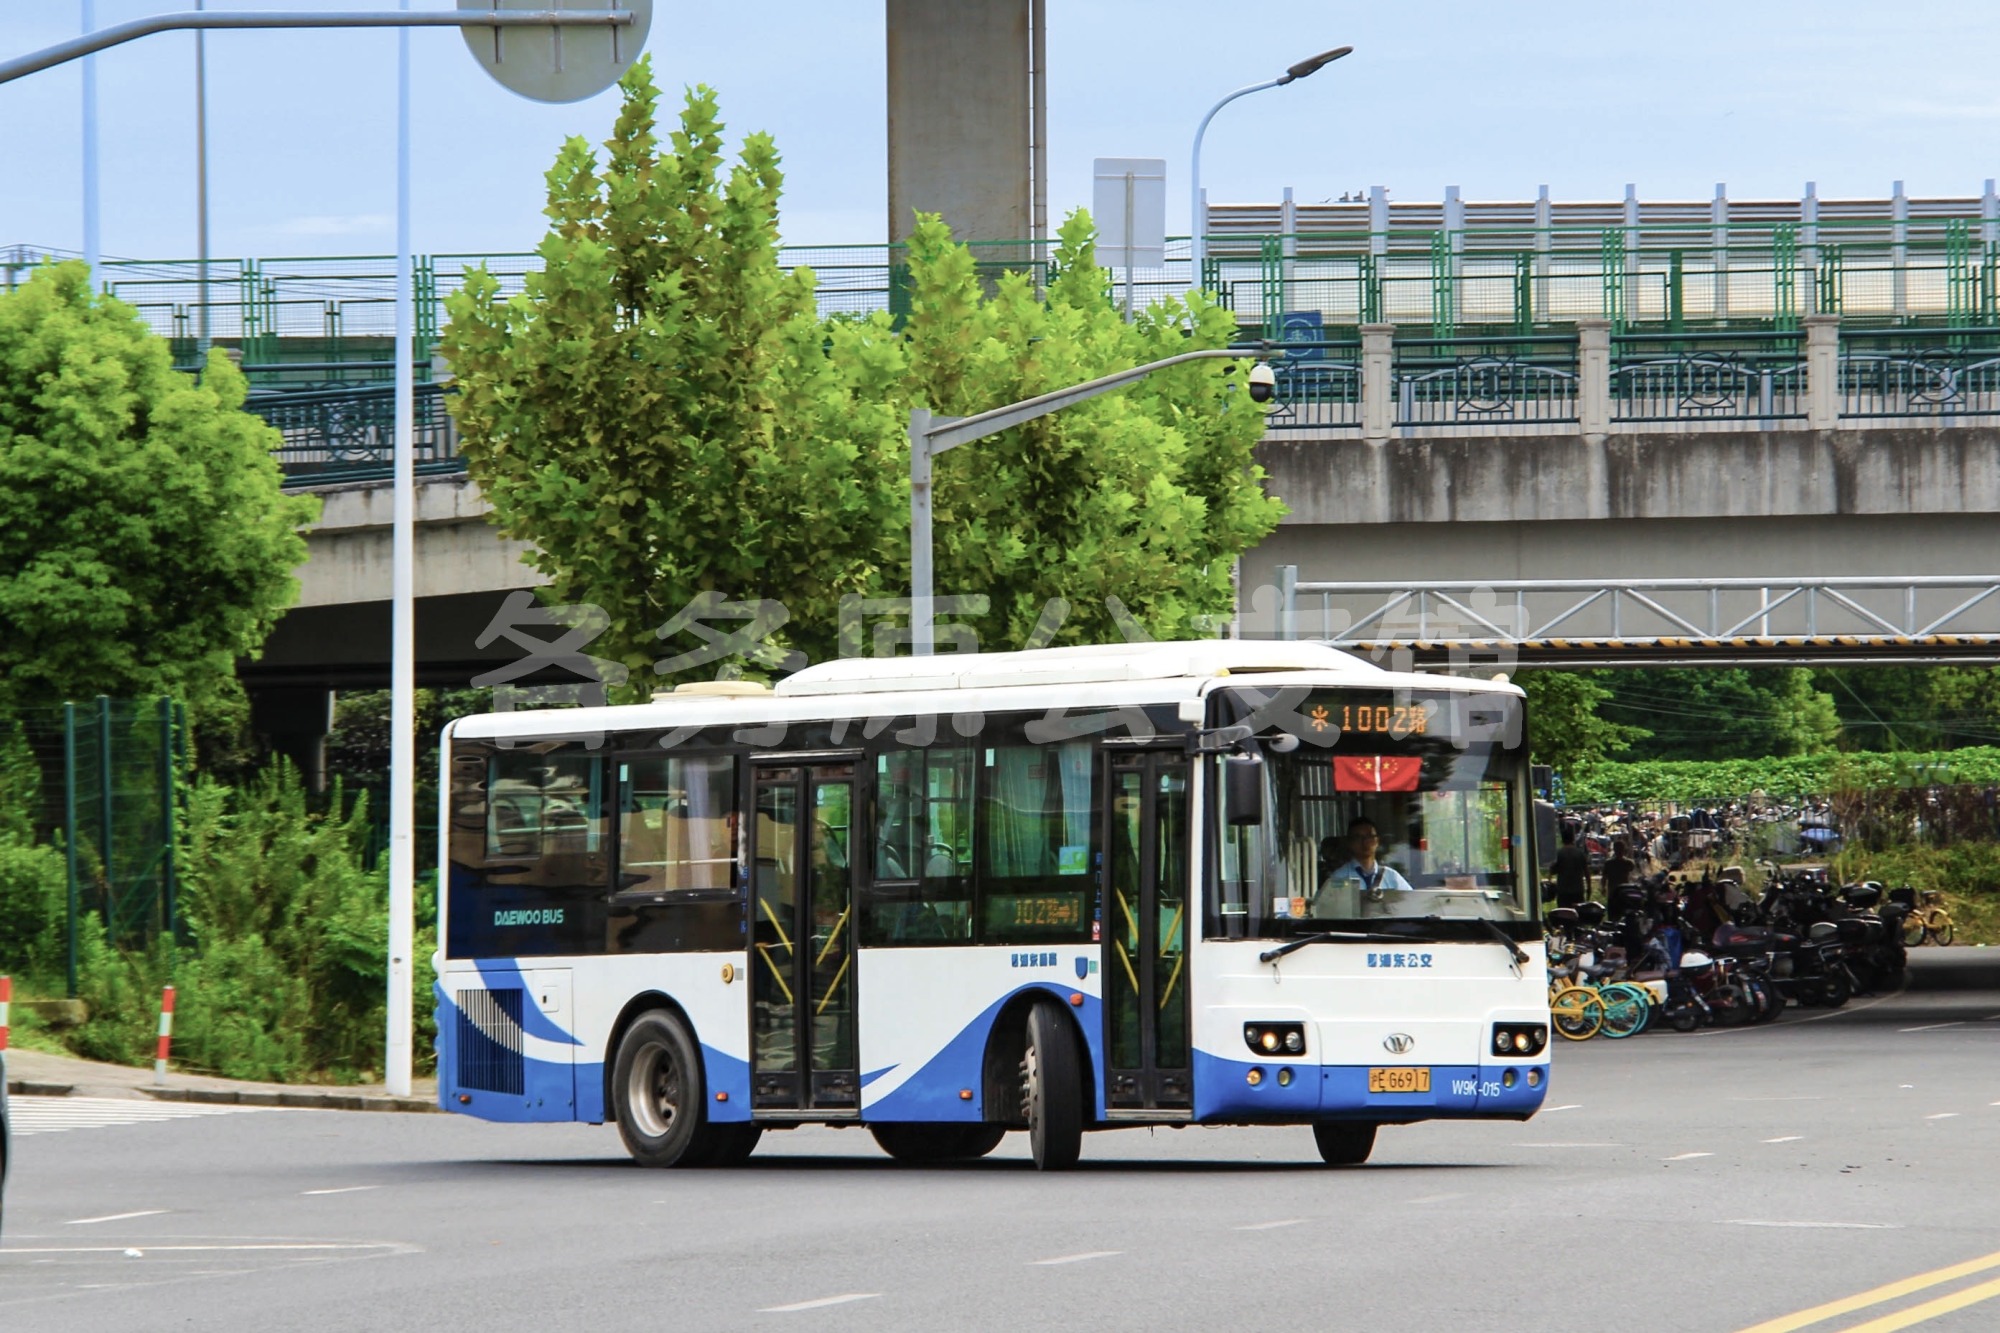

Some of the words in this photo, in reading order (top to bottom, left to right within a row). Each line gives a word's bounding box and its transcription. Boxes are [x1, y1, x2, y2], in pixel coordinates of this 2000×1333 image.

[494, 909, 541, 926] DAEWOO
[542, 908, 564, 925] BUS
[1452, 1080, 1501, 1097] W9K-015
